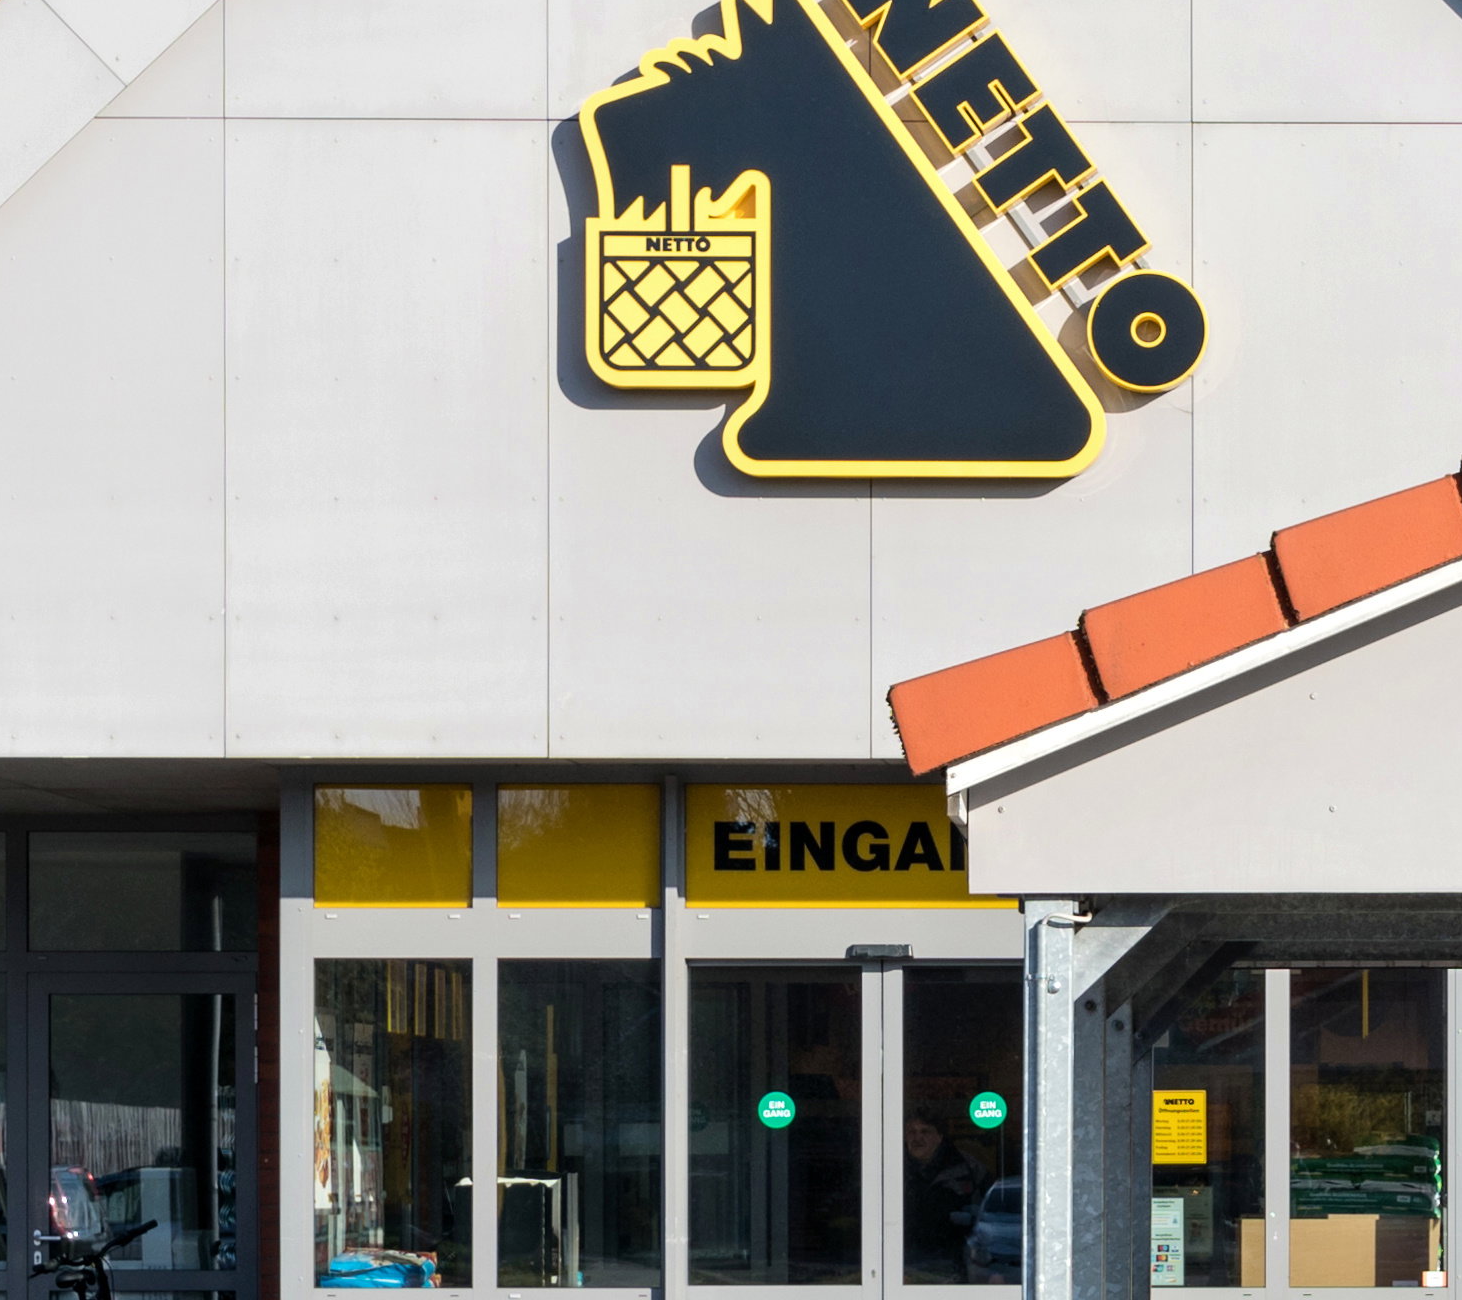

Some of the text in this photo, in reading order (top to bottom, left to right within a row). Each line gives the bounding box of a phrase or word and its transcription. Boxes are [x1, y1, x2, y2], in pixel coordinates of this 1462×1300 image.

[645, 236, 711, 252] NETTO
[768, 1101, 785, 1109] EIN
[979, 1101, 997, 1109] EIN
[763, 1110, 791, 1118] GANG
[974, 1110, 1002, 1118] GANG
